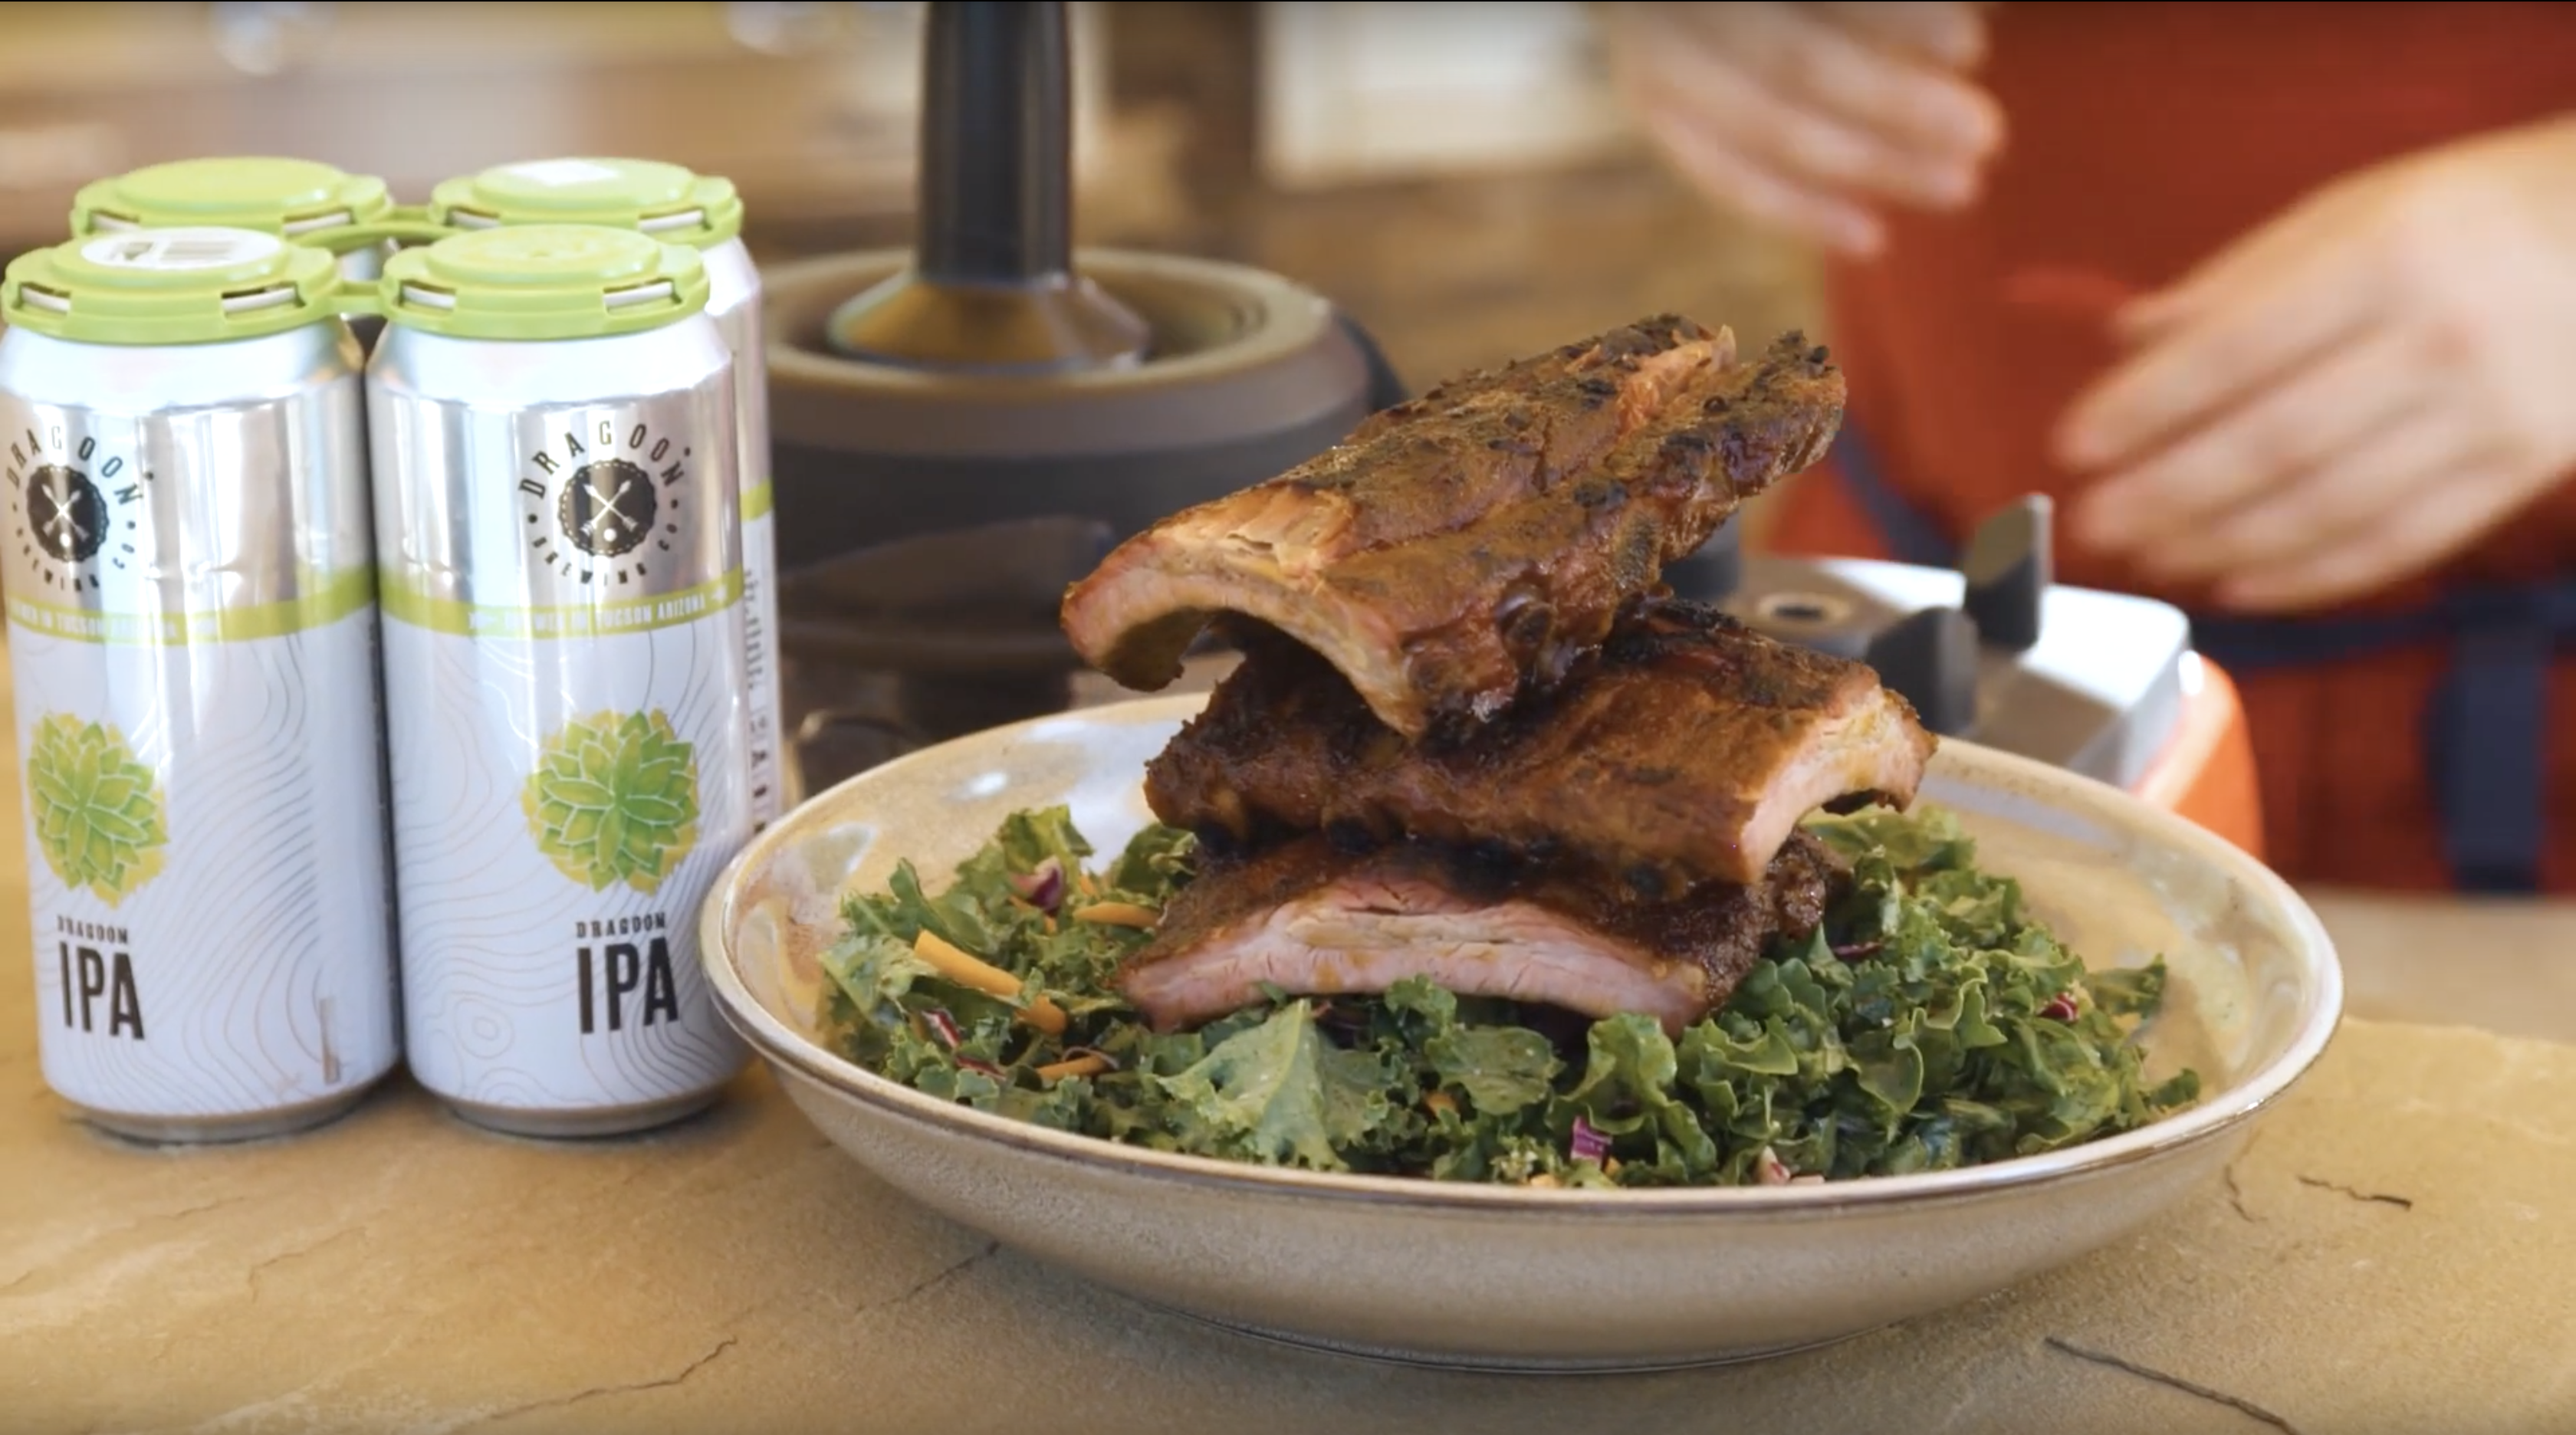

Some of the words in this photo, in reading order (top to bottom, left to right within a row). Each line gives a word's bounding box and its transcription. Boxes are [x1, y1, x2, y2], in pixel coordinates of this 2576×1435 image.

[7, 425, 143, 505] DRAGOON
[518, 420, 685, 500] DRAGOON
[657, 593, 706, 621] ARIZONA
[58, 914, 129, 945] DRAGOON
[577, 911, 665, 939] DRAGOON
[59, 940, 145, 1041] IPA
[577, 936, 679, 1034] IPA
